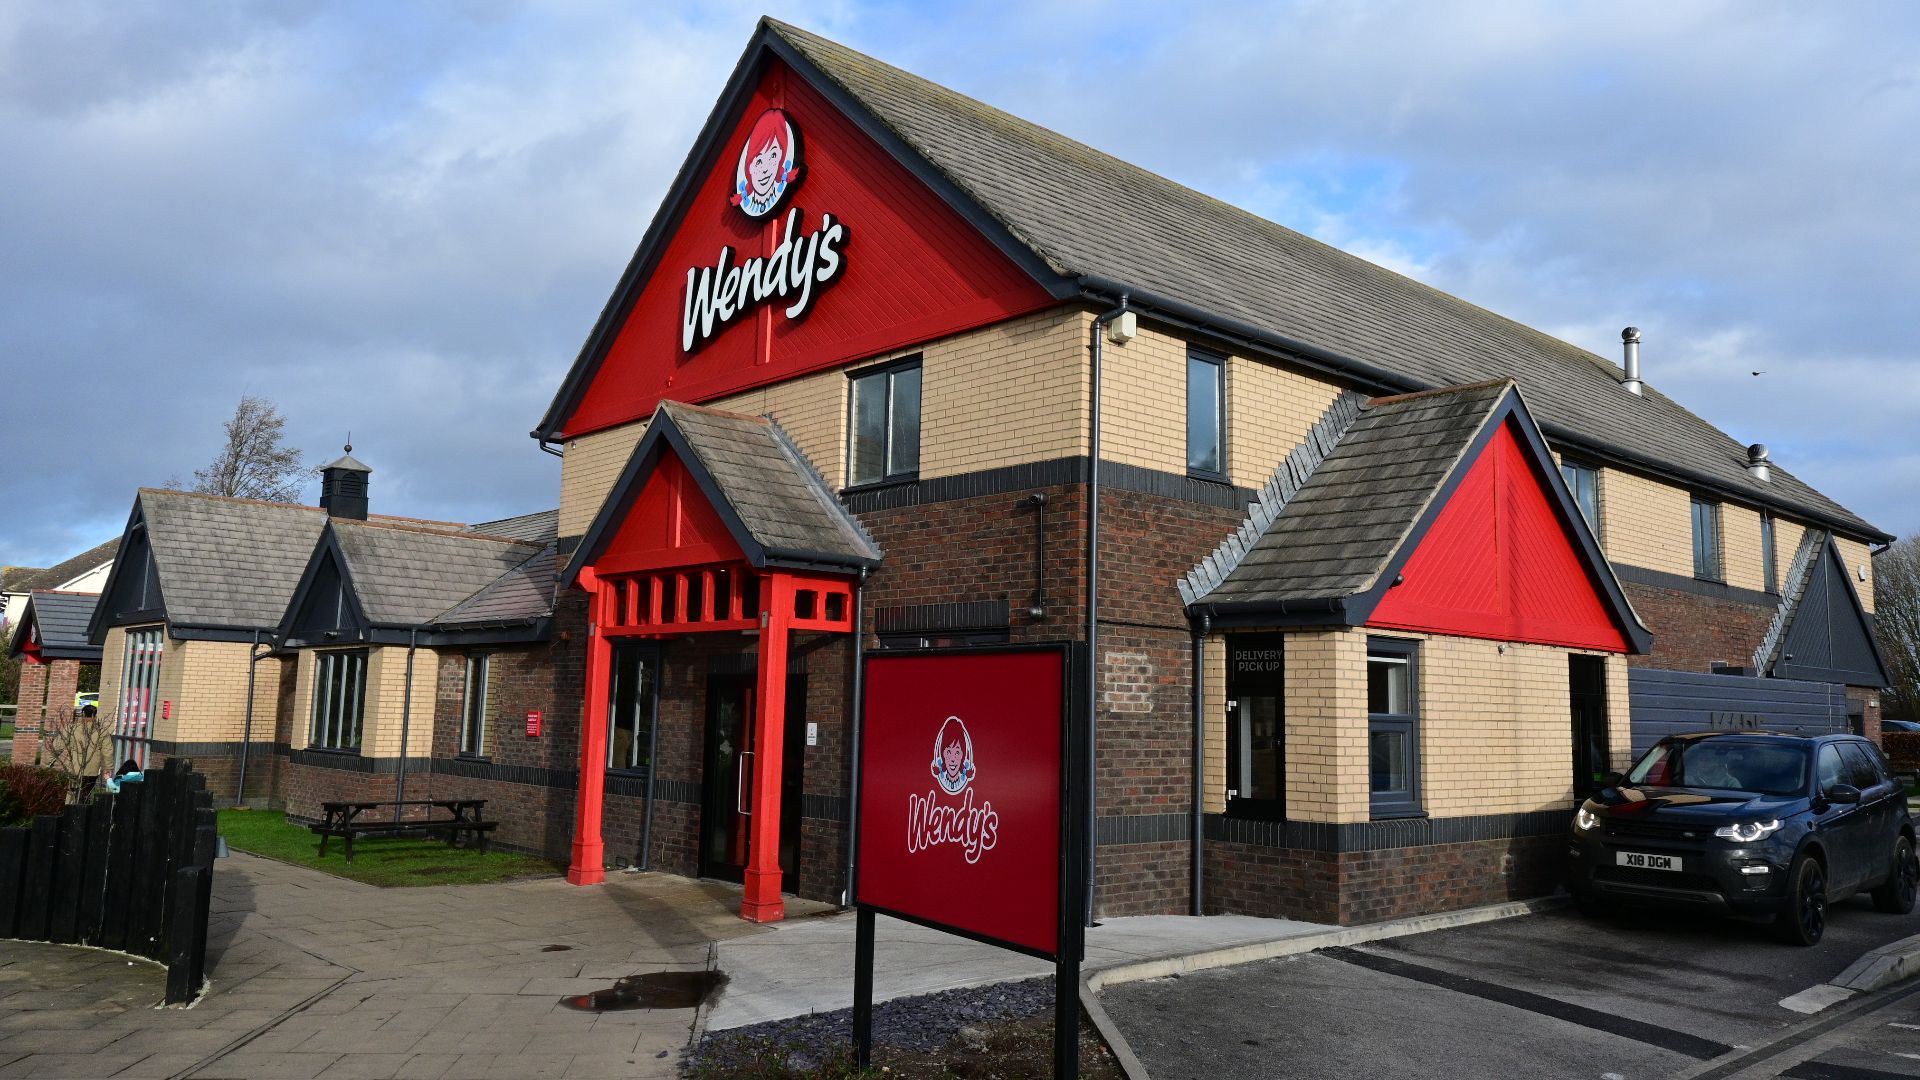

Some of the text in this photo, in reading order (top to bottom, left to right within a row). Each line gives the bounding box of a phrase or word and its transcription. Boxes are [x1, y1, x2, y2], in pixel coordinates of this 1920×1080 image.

[682, 207, 845, 352] Wendy's
[1235, 650, 1282, 660] DELIVERY
[1238, 661, 1280, 671] PICK UP
[908, 787, 998, 864] Wendy's
[1626, 853, 1645, 867] X18
